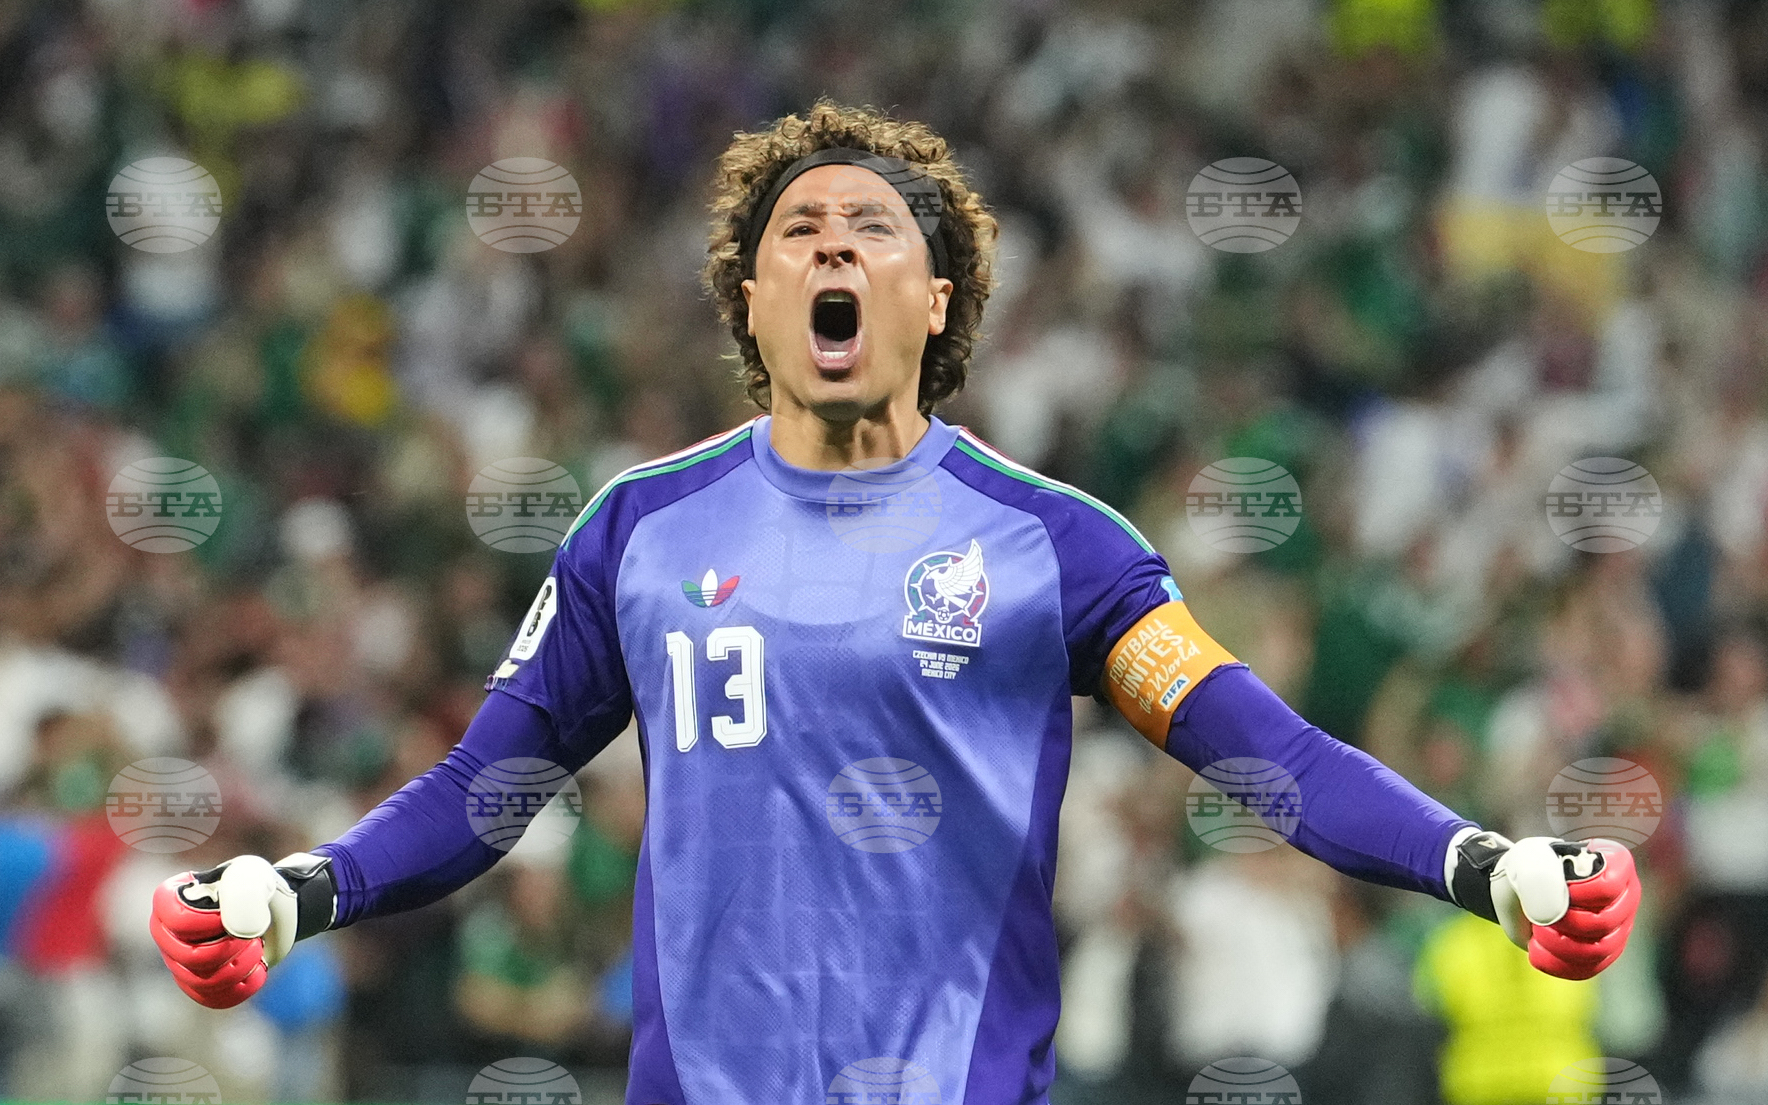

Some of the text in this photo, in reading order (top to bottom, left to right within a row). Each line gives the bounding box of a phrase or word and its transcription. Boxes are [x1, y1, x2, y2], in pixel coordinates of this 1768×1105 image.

[907, 620, 977, 642] MÉXICO
[1109, 618, 1169, 685] FOOTBALL
[1121, 629, 1184, 698] UNITES
[666, 626, 767, 752] 13
[1139, 640, 1201, 714] the World
[1162, 679, 1186, 706] FIFA
